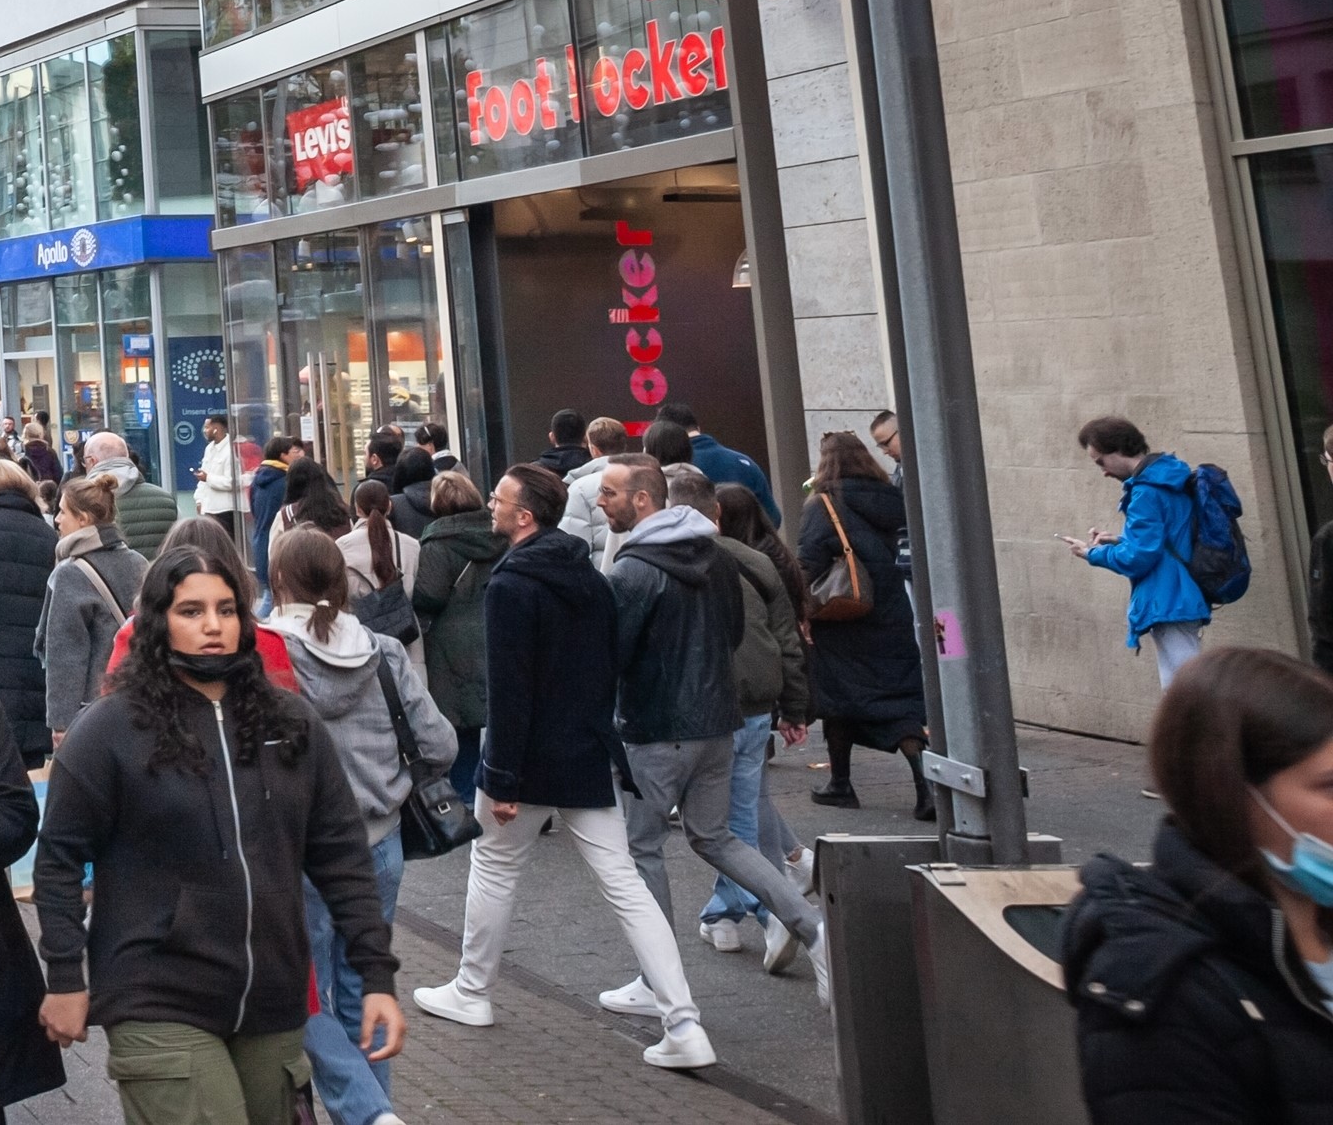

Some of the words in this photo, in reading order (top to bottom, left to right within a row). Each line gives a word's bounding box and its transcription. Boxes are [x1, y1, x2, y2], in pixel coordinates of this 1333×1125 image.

[465, 56, 558, 147] Foot
[37, 241, 69, 271] Apollo
[207, 408, 228, 416] Garan
